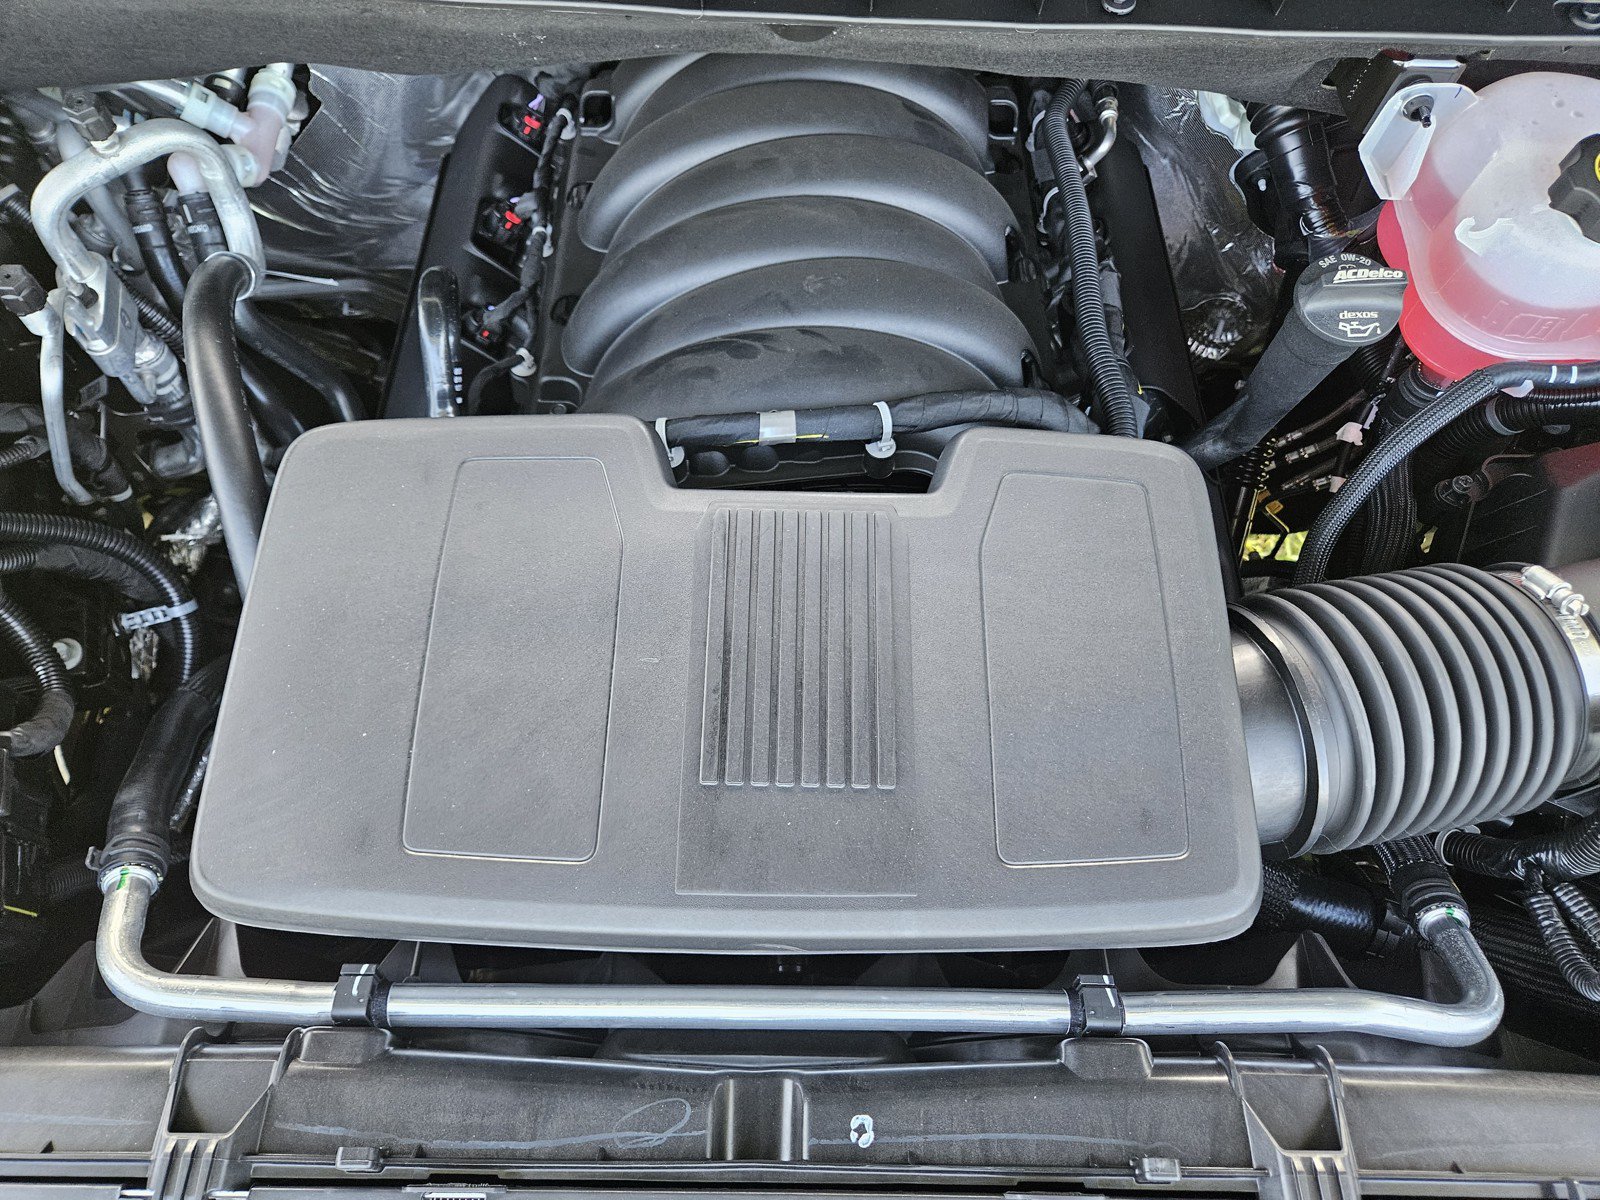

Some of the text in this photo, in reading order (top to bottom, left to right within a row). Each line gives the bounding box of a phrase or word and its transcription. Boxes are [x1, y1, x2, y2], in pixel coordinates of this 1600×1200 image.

[1318, 253, 1372, 268] SAE 0W-20
[1333, 268, 1403, 280] ACDelco
[1339, 310, 1379, 319] dexos
